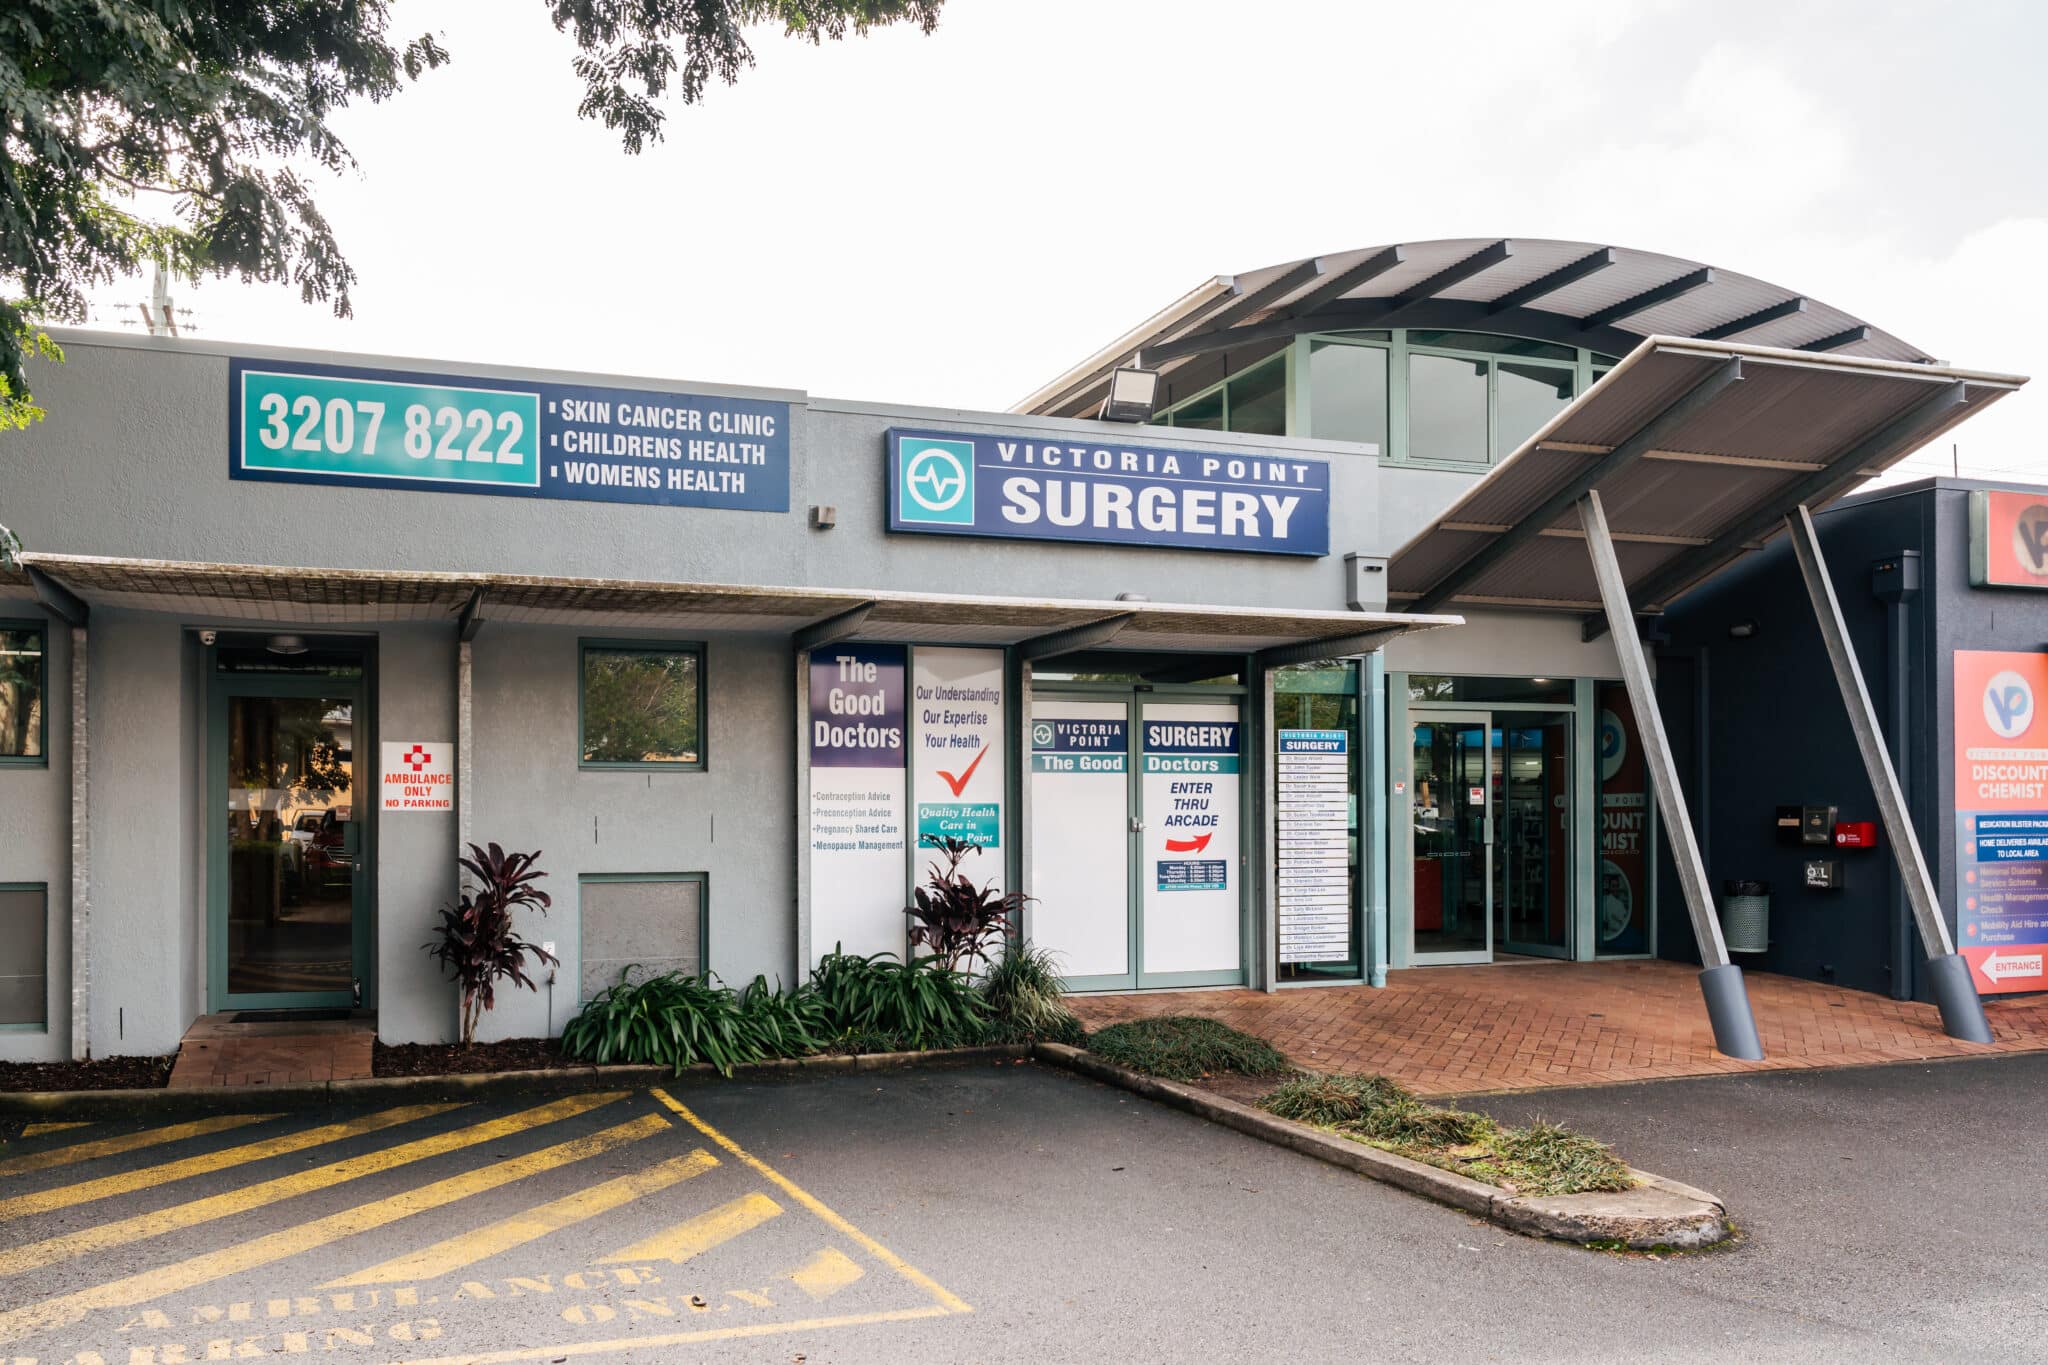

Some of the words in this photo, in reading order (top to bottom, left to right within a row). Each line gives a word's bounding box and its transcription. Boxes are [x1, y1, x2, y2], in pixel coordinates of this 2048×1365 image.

[561, 399, 610, 424] SKIN
[617, 403, 702, 432] CANCER
[708, 411, 775, 437] CLINIC
[259, 393, 386, 455] 3207
[404, 404, 524, 465] 8222
[563, 430, 682, 460] CHILDRENS
[688, 439, 766, 465] HEALTH
[998, 442, 1181, 475] VICTORIA
[1203, 459, 1309, 484] POINT
[564, 462, 661, 489] WOMENS
[667, 468, 745, 494] HEALTH
[1001, 477, 1301, 539] SURGERY
[836, 655, 877, 683] The
[829, 688, 885, 715] Good
[916, 685, 933, 700] Our
[935, 685, 1000, 705] Understanding
[923, 709, 941, 724] Our
[943, 709, 988, 728] Expertise
[815, 720, 901, 748] Doctors
[1057, 724, 1121, 736] VICTORIA
[1149, 726, 1233, 748] SURGERY
[925, 732, 947, 748] Your
[950, 733, 980, 748] Health
[1070, 736, 1110, 747] POINT
[1286, 741, 1340, 750] SURGERY
[1042, 756, 1074, 770] The
[1079, 756, 1123, 770] Good
[1148, 757, 1219, 771] Doctors
[384, 774, 452, 784] AMBULANCE
[1972, 765, 2048, 780] DISCOUNT
[404, 786, 432, 796] ONLY
[1170, 782, 1213, 794] ENTER
[1978, 783, 2044, 799] CHEMIST
[385, 799, 399, 807] NO
[404, 799, 449, 807] PARKING
[816, 792, 866, 802] Contraception
[868, 792, 891, 801] Advice
[1174, 798, 1209, 810] THRU
[816, 808, 867, 818] Preconception
[869, 808, 892, 817] Advice
[920, 807, 959, 819] Quality
[961, 807, 996, 817] Health
[1165, 815, 1219, 826] ARCADE
[816, 825, 853, 835] Pregnancy
[855, 824, 880, 833] Shared
[881, 824, 898, 833] Care
[940, 820, 963, 830] Care
[966, 820, 977, 830] in
[816, 841, 857, 851] Menopause
[858, 841, 903, 851] Management
[2006, 850, 2023, 858] LOCAL
[2024, 849, 2039, 857] AREA
[1995, 961, 2041, 971] ENTRANCE
[115, 1267, 661, 1331] AMBULANCE
[561, 1287, 776, 1324] ONLY
